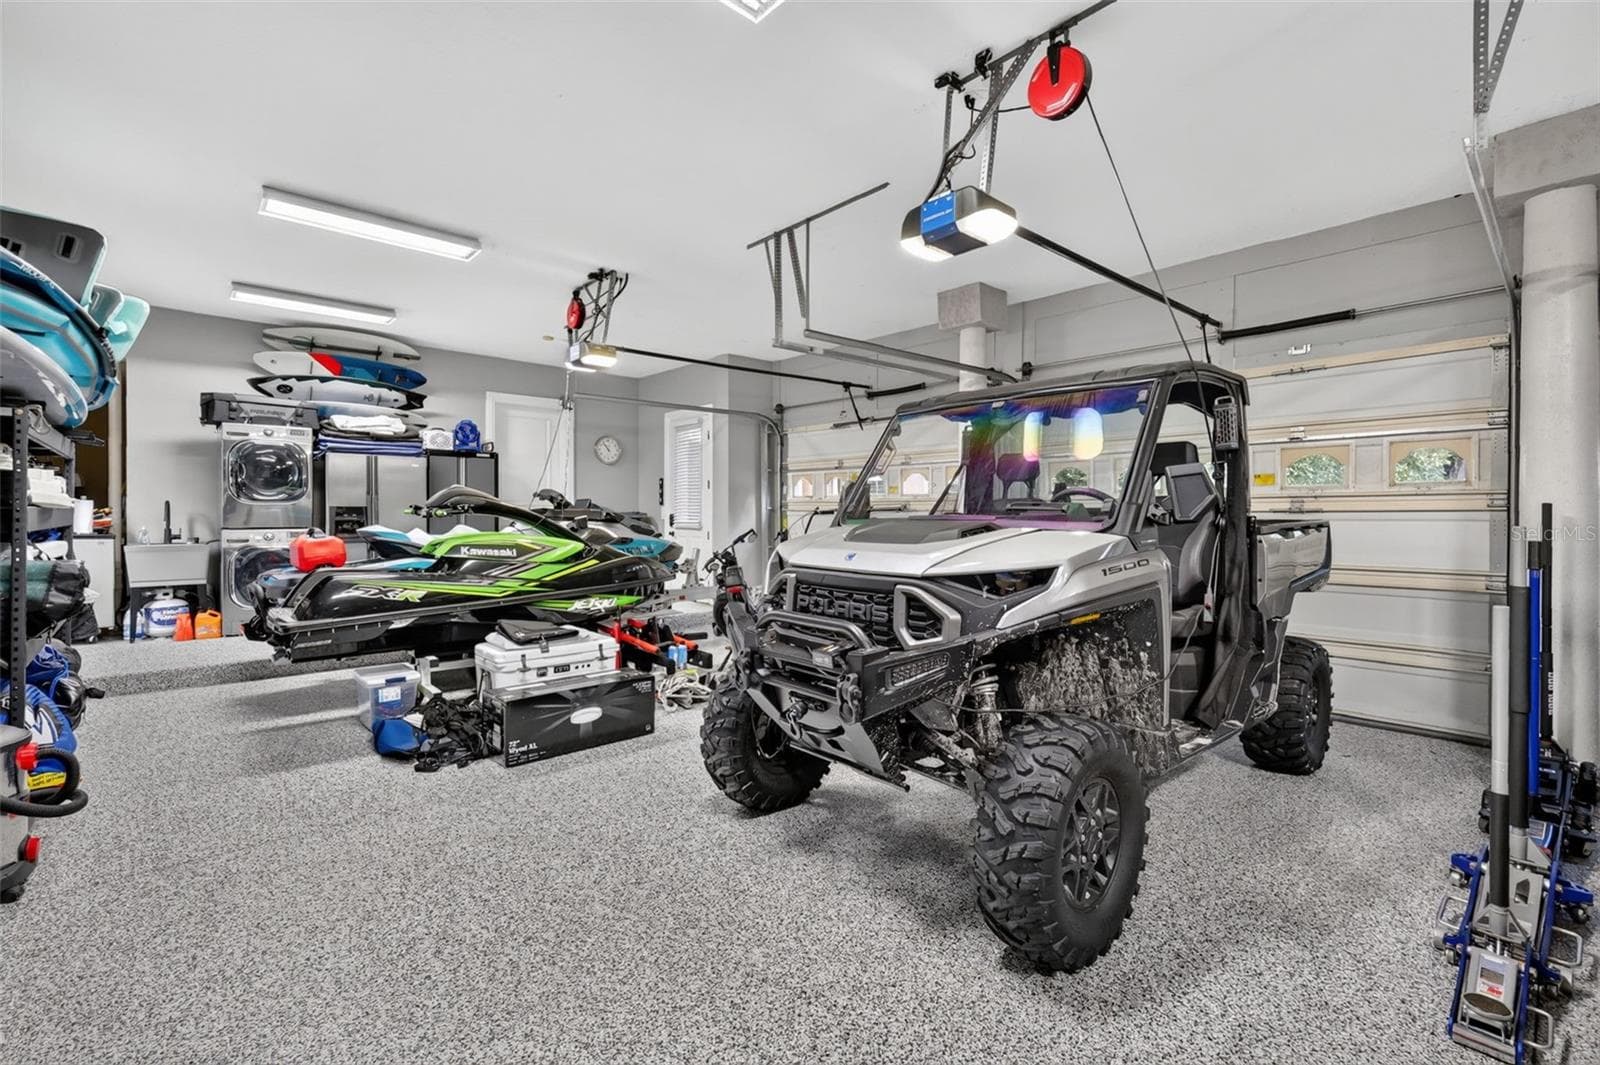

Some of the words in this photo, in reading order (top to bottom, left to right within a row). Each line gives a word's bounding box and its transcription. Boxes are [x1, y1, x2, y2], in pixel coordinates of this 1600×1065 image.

[460, 546, 517, 557] Kawasaki
[1101, 558, 1150, 577] 1500
[796, 594, 889, 623] POLARIS
